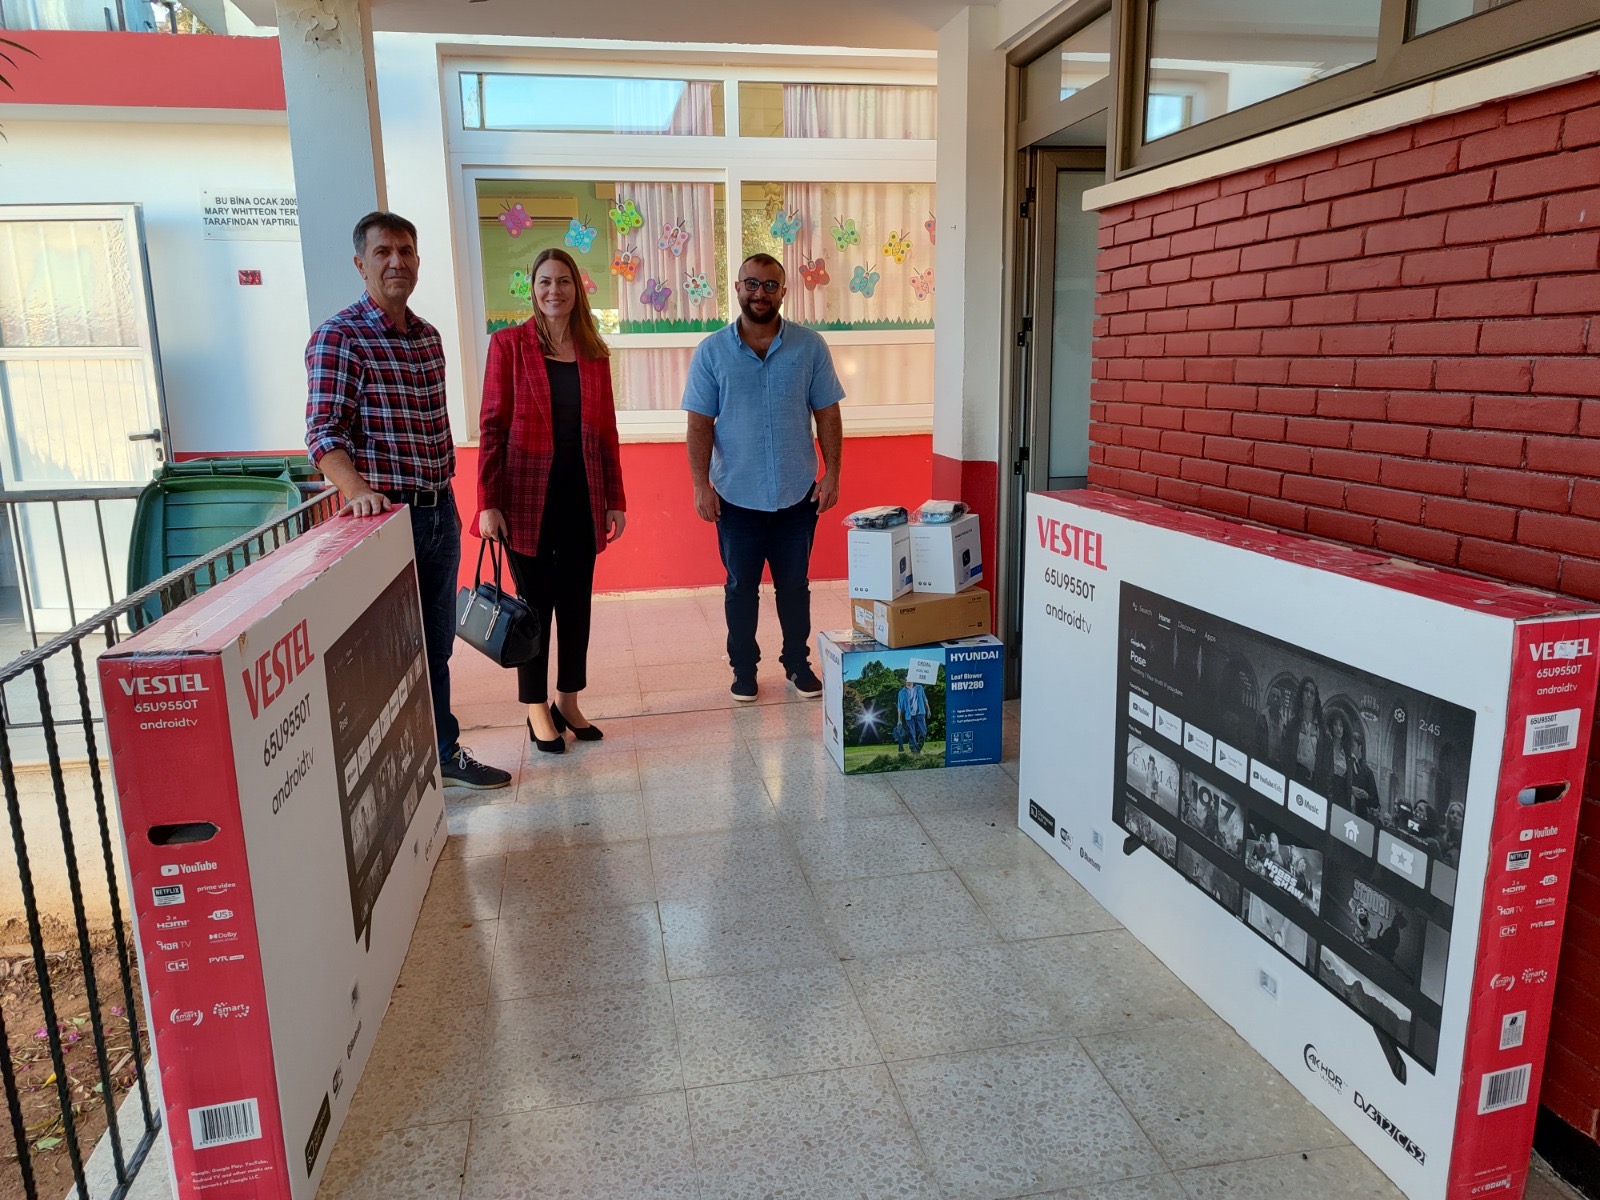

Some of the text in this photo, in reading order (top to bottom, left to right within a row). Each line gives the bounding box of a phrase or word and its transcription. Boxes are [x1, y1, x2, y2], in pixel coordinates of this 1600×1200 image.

[216, 197, 227, 205] BU
[230, 196, 251, 205] BİNA
[203, 218, 258, 226] TARAFINDAN
[1037, 514, 1108, 571] VESTEL
[1044, 567, 1095, 602] 65U9550T
[1158, 612, 1171, 624] Home
[1178, 620, 1196, 634] Discover
[1204, 632, 1216, 643] Apps
[950, 651, 999, 662] HYUNDAI
[1130, 650, 1147, 667] Pose
[242, 618, 315, 720] VESTEL
[1536, 664, 1582, 679] 65U9550T
[118, 674, 210, 696] VESTEL
[951, 680, 984, 691] HBV280
[135, 700, 199, 713] 65U9550T
[1530, 714, 1558, 725] 65U9550T
[264, 693, 311, 767] 65U9550T
[1420, 720, 1440, 737] 2:45
[1192, 780, 1236, 824] 1917
[1304, 800, 1319, 815] Music
[1534, 826, 1559, 838] YouTube
[1510, 851, 1529, 861] NETFLIX
[180, 861, 218, 874] YouTube
[1264, 858, 1298, 887] HOBBS
[155, 887, 180, 896] NETFLIX
[197, 882, 236, 893] prime video
[218, 932, 238, 940] Dolby
[180, 941, 192, 949] TV
[167, 961, 189, 971] CI+
[1525, 970, 1545, 978] smart
[218, 1004, 245, 1014] smart
[176, 1012, 198, 1021] smart
[1308, 1054, 1343, 1089] 4K HDR
